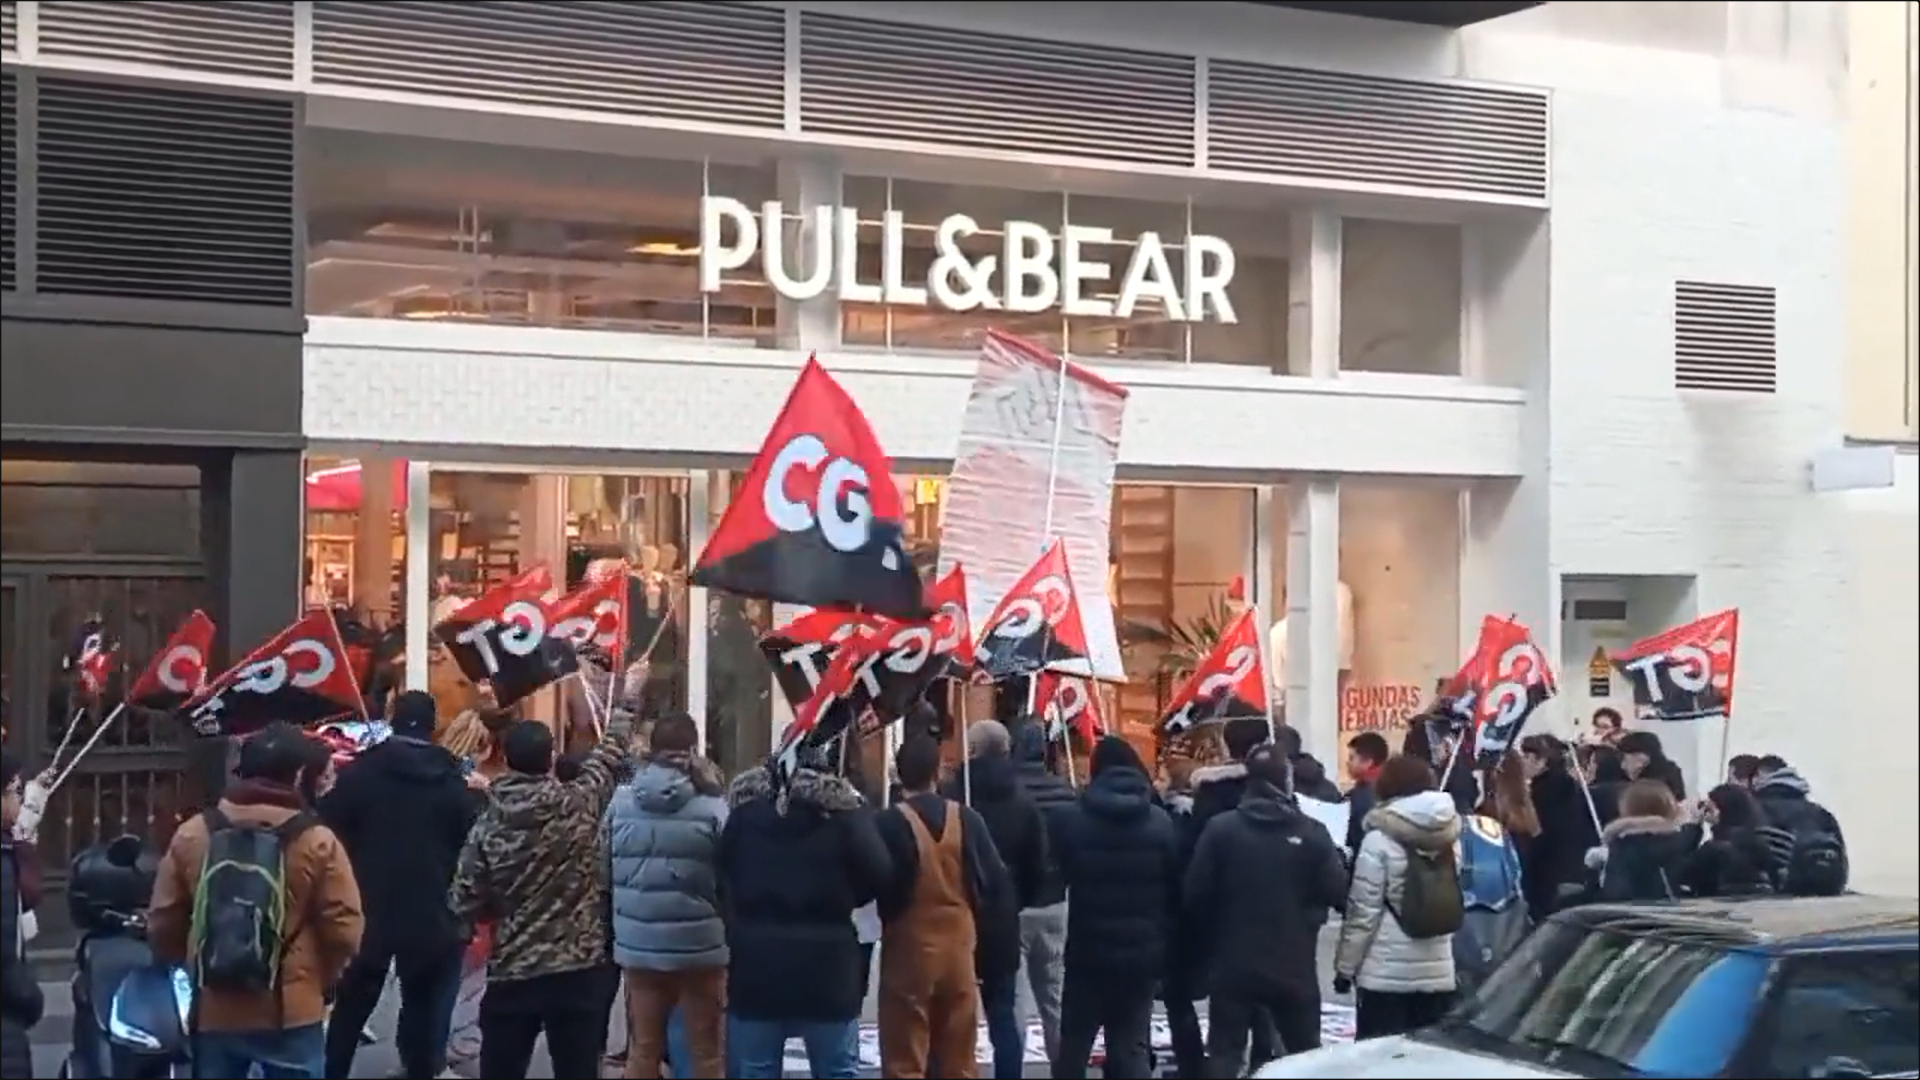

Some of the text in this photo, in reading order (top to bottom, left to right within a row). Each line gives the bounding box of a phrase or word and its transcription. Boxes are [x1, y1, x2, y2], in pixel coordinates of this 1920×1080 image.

[700, 196, 1238, 324] PULL&BEAR
[763, 435, 901, 571] CG
[1343, 707, 1411, 731] EBAJAS
[1345, 685, 1421, 709] GUNDAS
